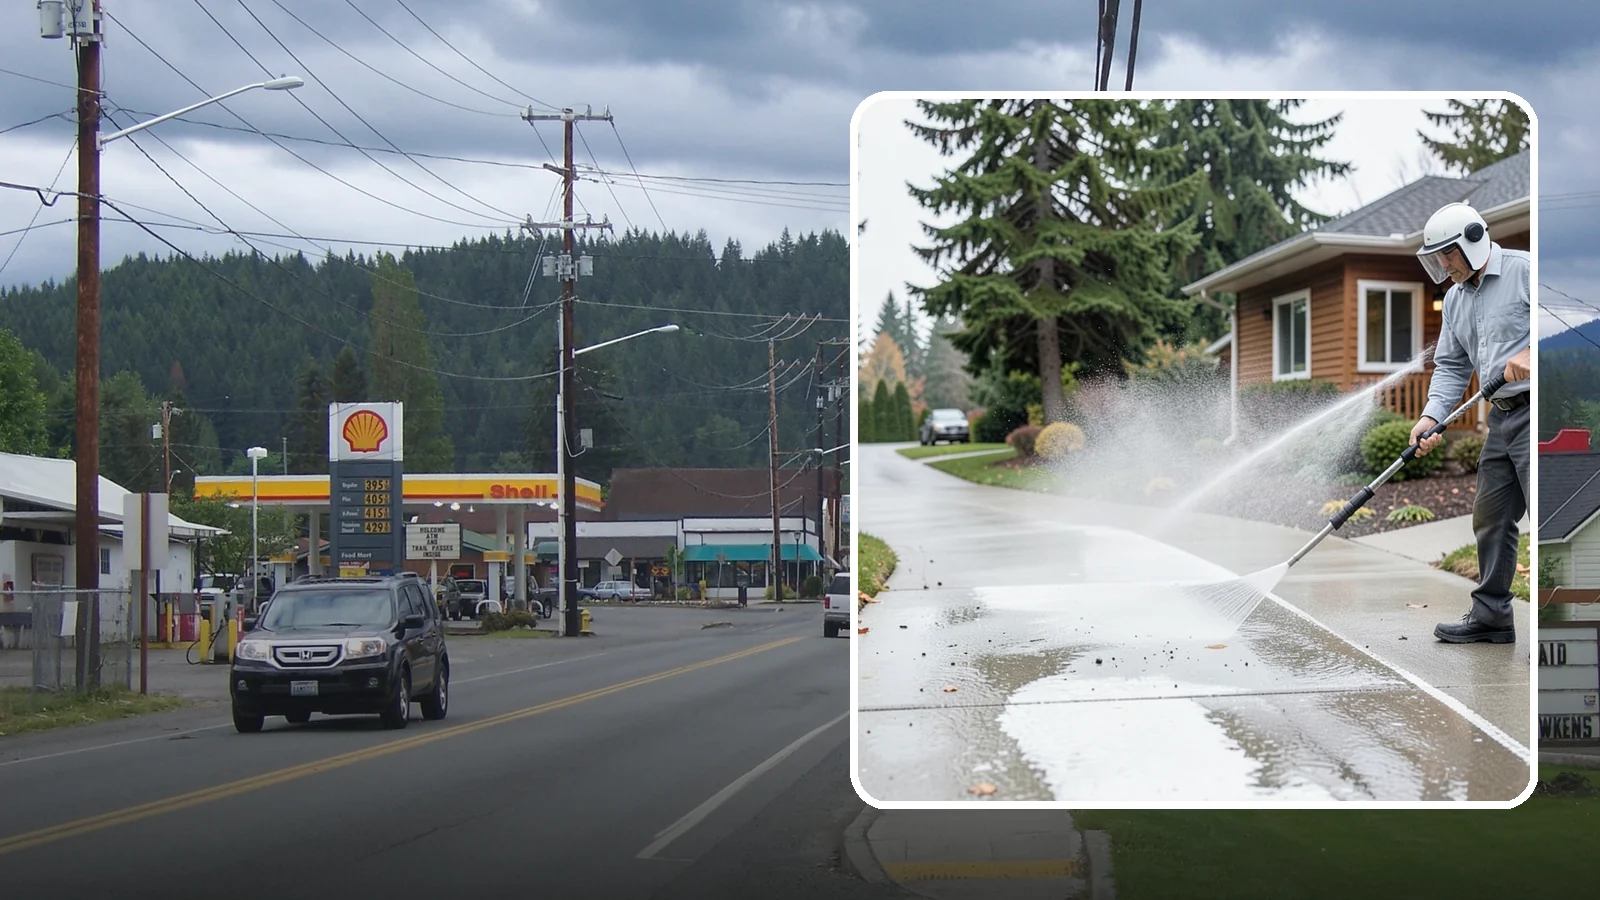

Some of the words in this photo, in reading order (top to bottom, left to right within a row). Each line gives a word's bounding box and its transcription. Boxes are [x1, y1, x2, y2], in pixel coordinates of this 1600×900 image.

[366, 480, 384, 490] 395
[490, 484, 547, 499] Shell
[365, 494, 383, 504] 405
[365, 508, 383, 518] 415
[365, 522, 383, 533] 429
